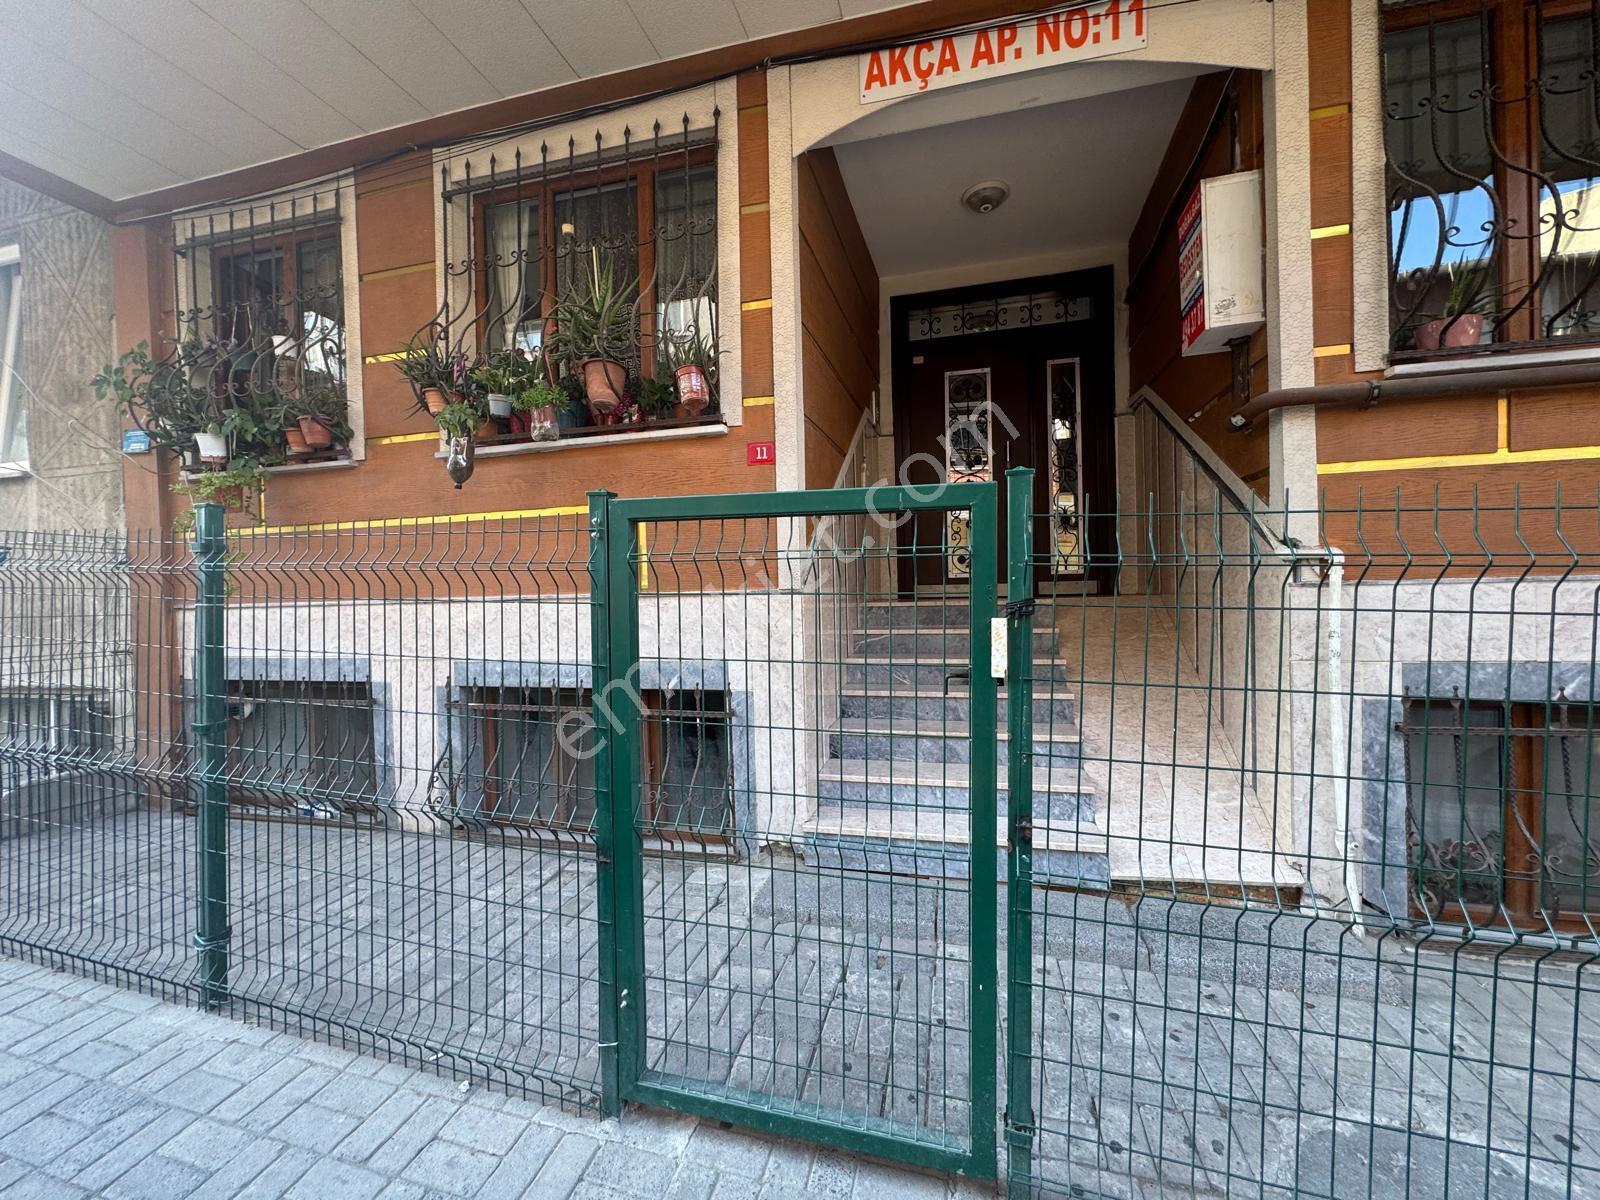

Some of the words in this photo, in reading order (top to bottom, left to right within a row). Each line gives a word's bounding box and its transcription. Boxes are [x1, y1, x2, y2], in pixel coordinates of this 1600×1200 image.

[864, 38, 961, 90] AKÇA
[970, 24, 1022, 69] AP.
[1036, 0, 1144, 55] NO:11
[756, 446, 768, 460] 11
